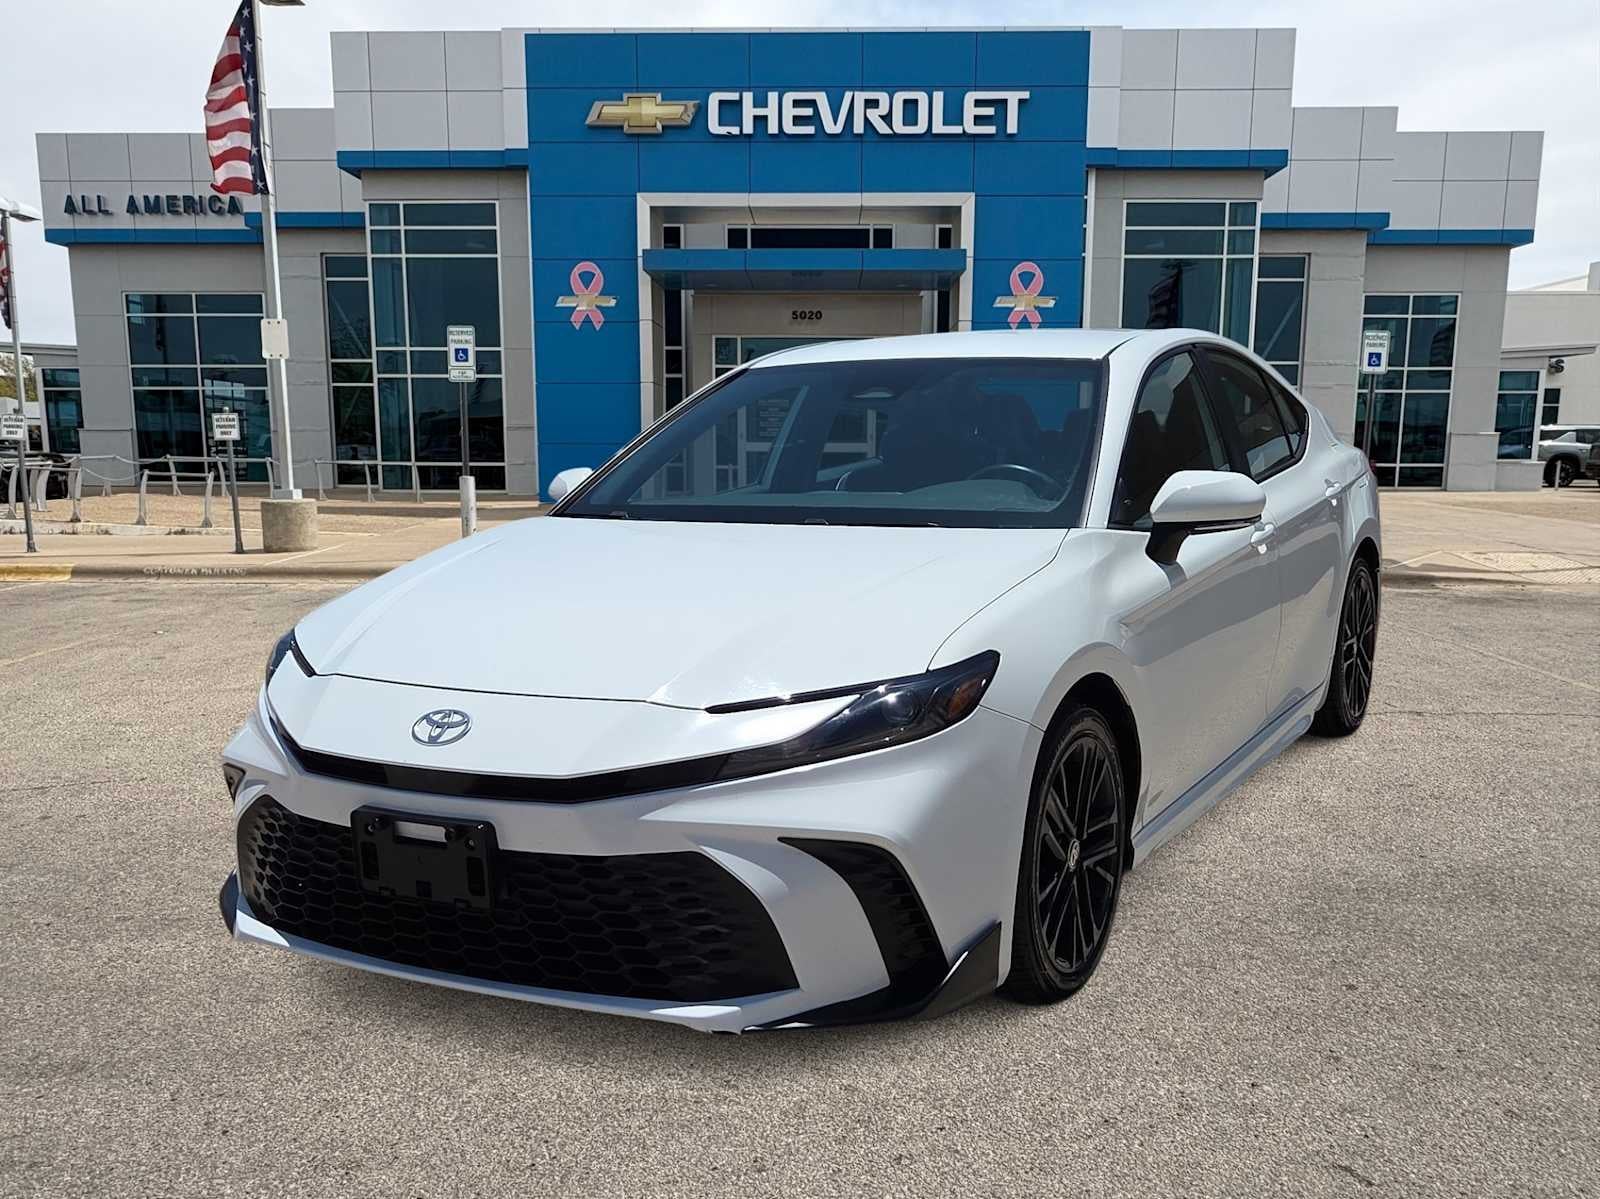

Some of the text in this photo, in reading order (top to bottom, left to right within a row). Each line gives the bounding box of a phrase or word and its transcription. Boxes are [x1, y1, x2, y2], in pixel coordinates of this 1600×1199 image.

[707, 90, 1031, 136] CHEVROLET
[64, 194, 244, 215] ALL AMERICA
[791, 310, 823, 320] 5020
